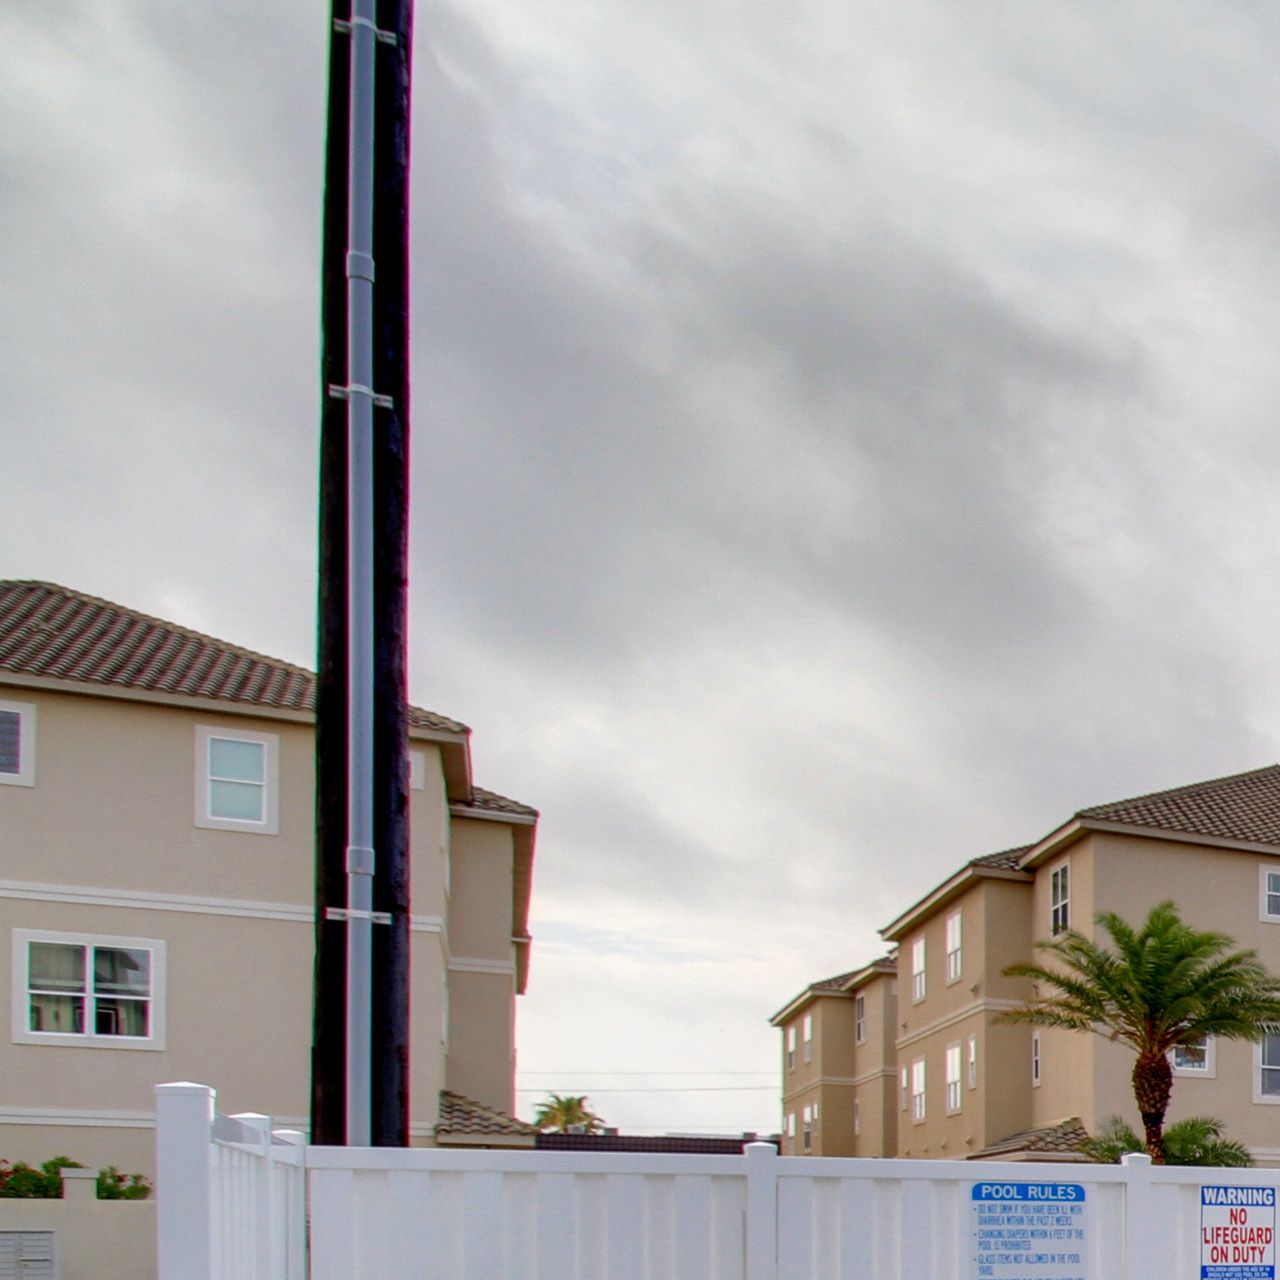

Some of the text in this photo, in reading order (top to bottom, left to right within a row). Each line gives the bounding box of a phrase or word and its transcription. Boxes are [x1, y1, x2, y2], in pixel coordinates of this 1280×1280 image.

[981, 1185, 1077, 1200] POOL RULES
[1203, 1187, 1274, 1206] WARNING
[1230, 1208, 1247, 1225] NO
[1203, 1227, 1272, 1244] LIFEGUARD
[1211, 1246, 1265, 1263] ON DUTY
